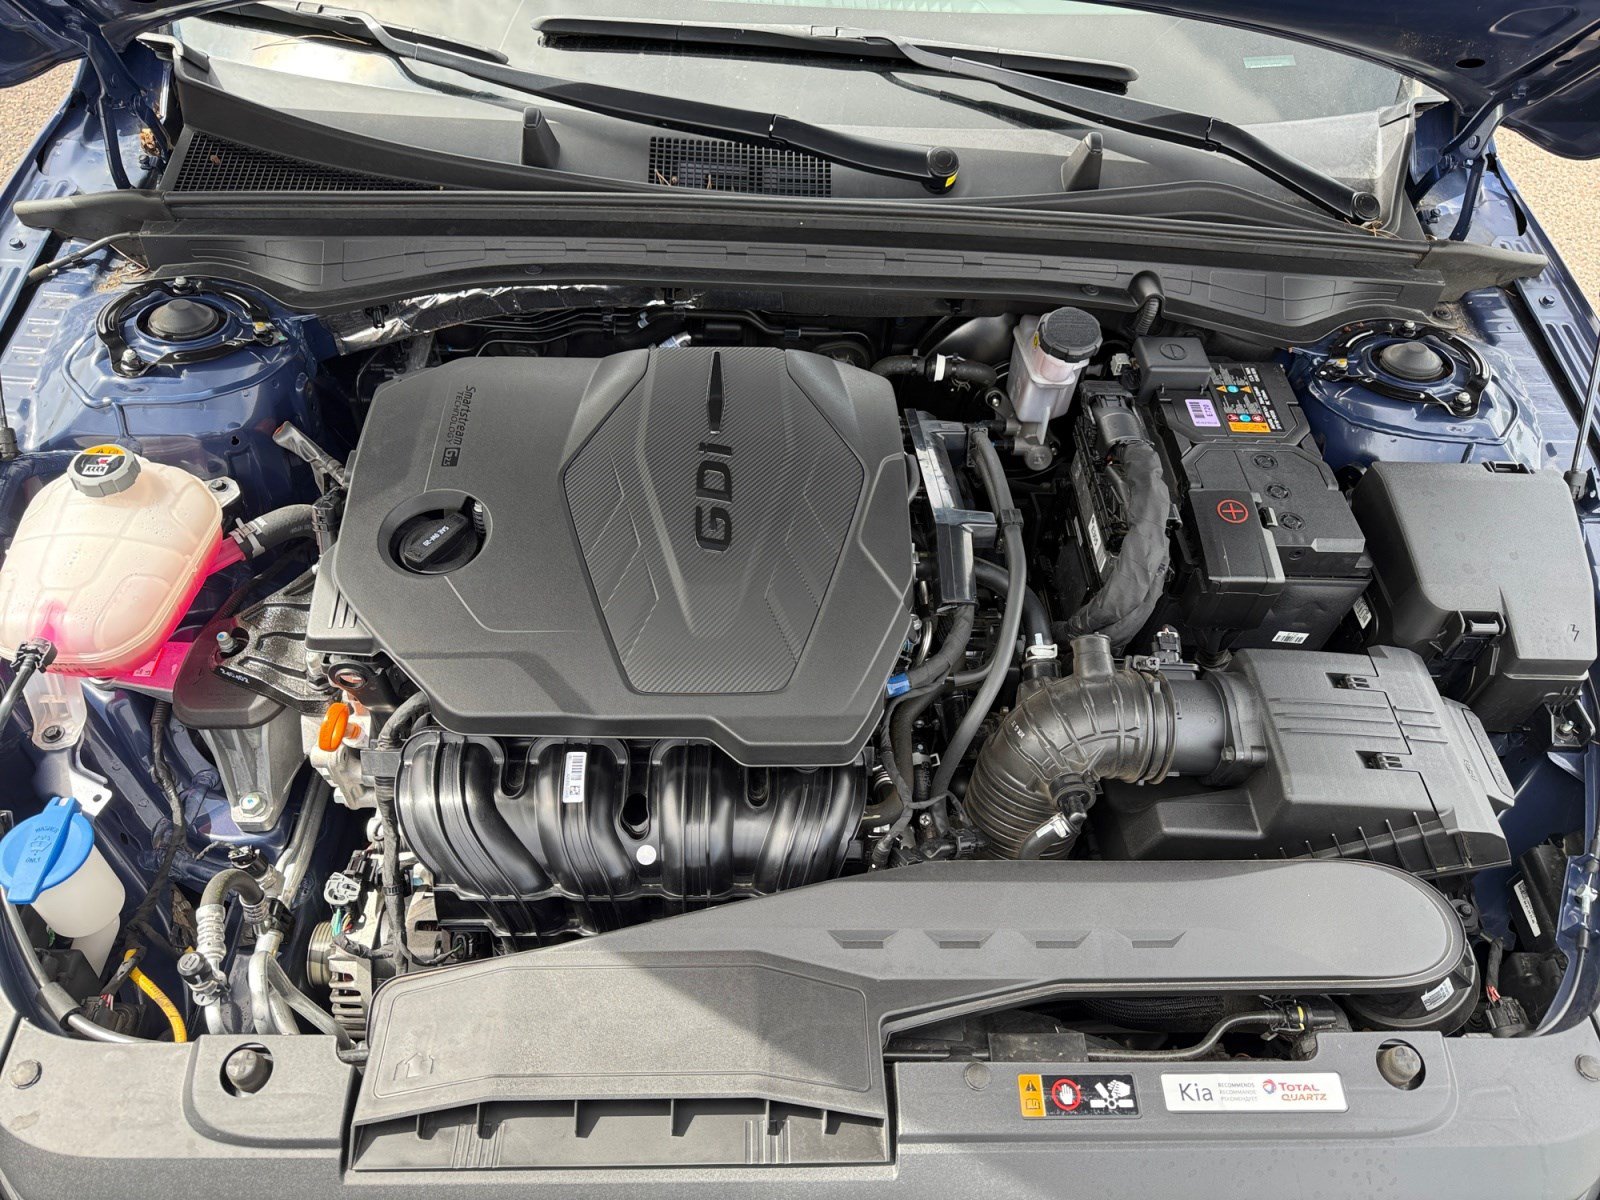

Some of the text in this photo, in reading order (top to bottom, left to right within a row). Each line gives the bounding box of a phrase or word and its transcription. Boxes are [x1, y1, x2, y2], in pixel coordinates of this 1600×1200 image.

[446, 391, 464, 445] TECHNOLOGY
[453, 385, 476, 446] Smartstream
[422, 525, 450, 547] SAE 0W-20
[1178, 1082, 1214, 1102] Kia
[1278, 1082, 1320, 1091] TOTAL
[1281, 1093, 1327, 1102] QUARTZ
